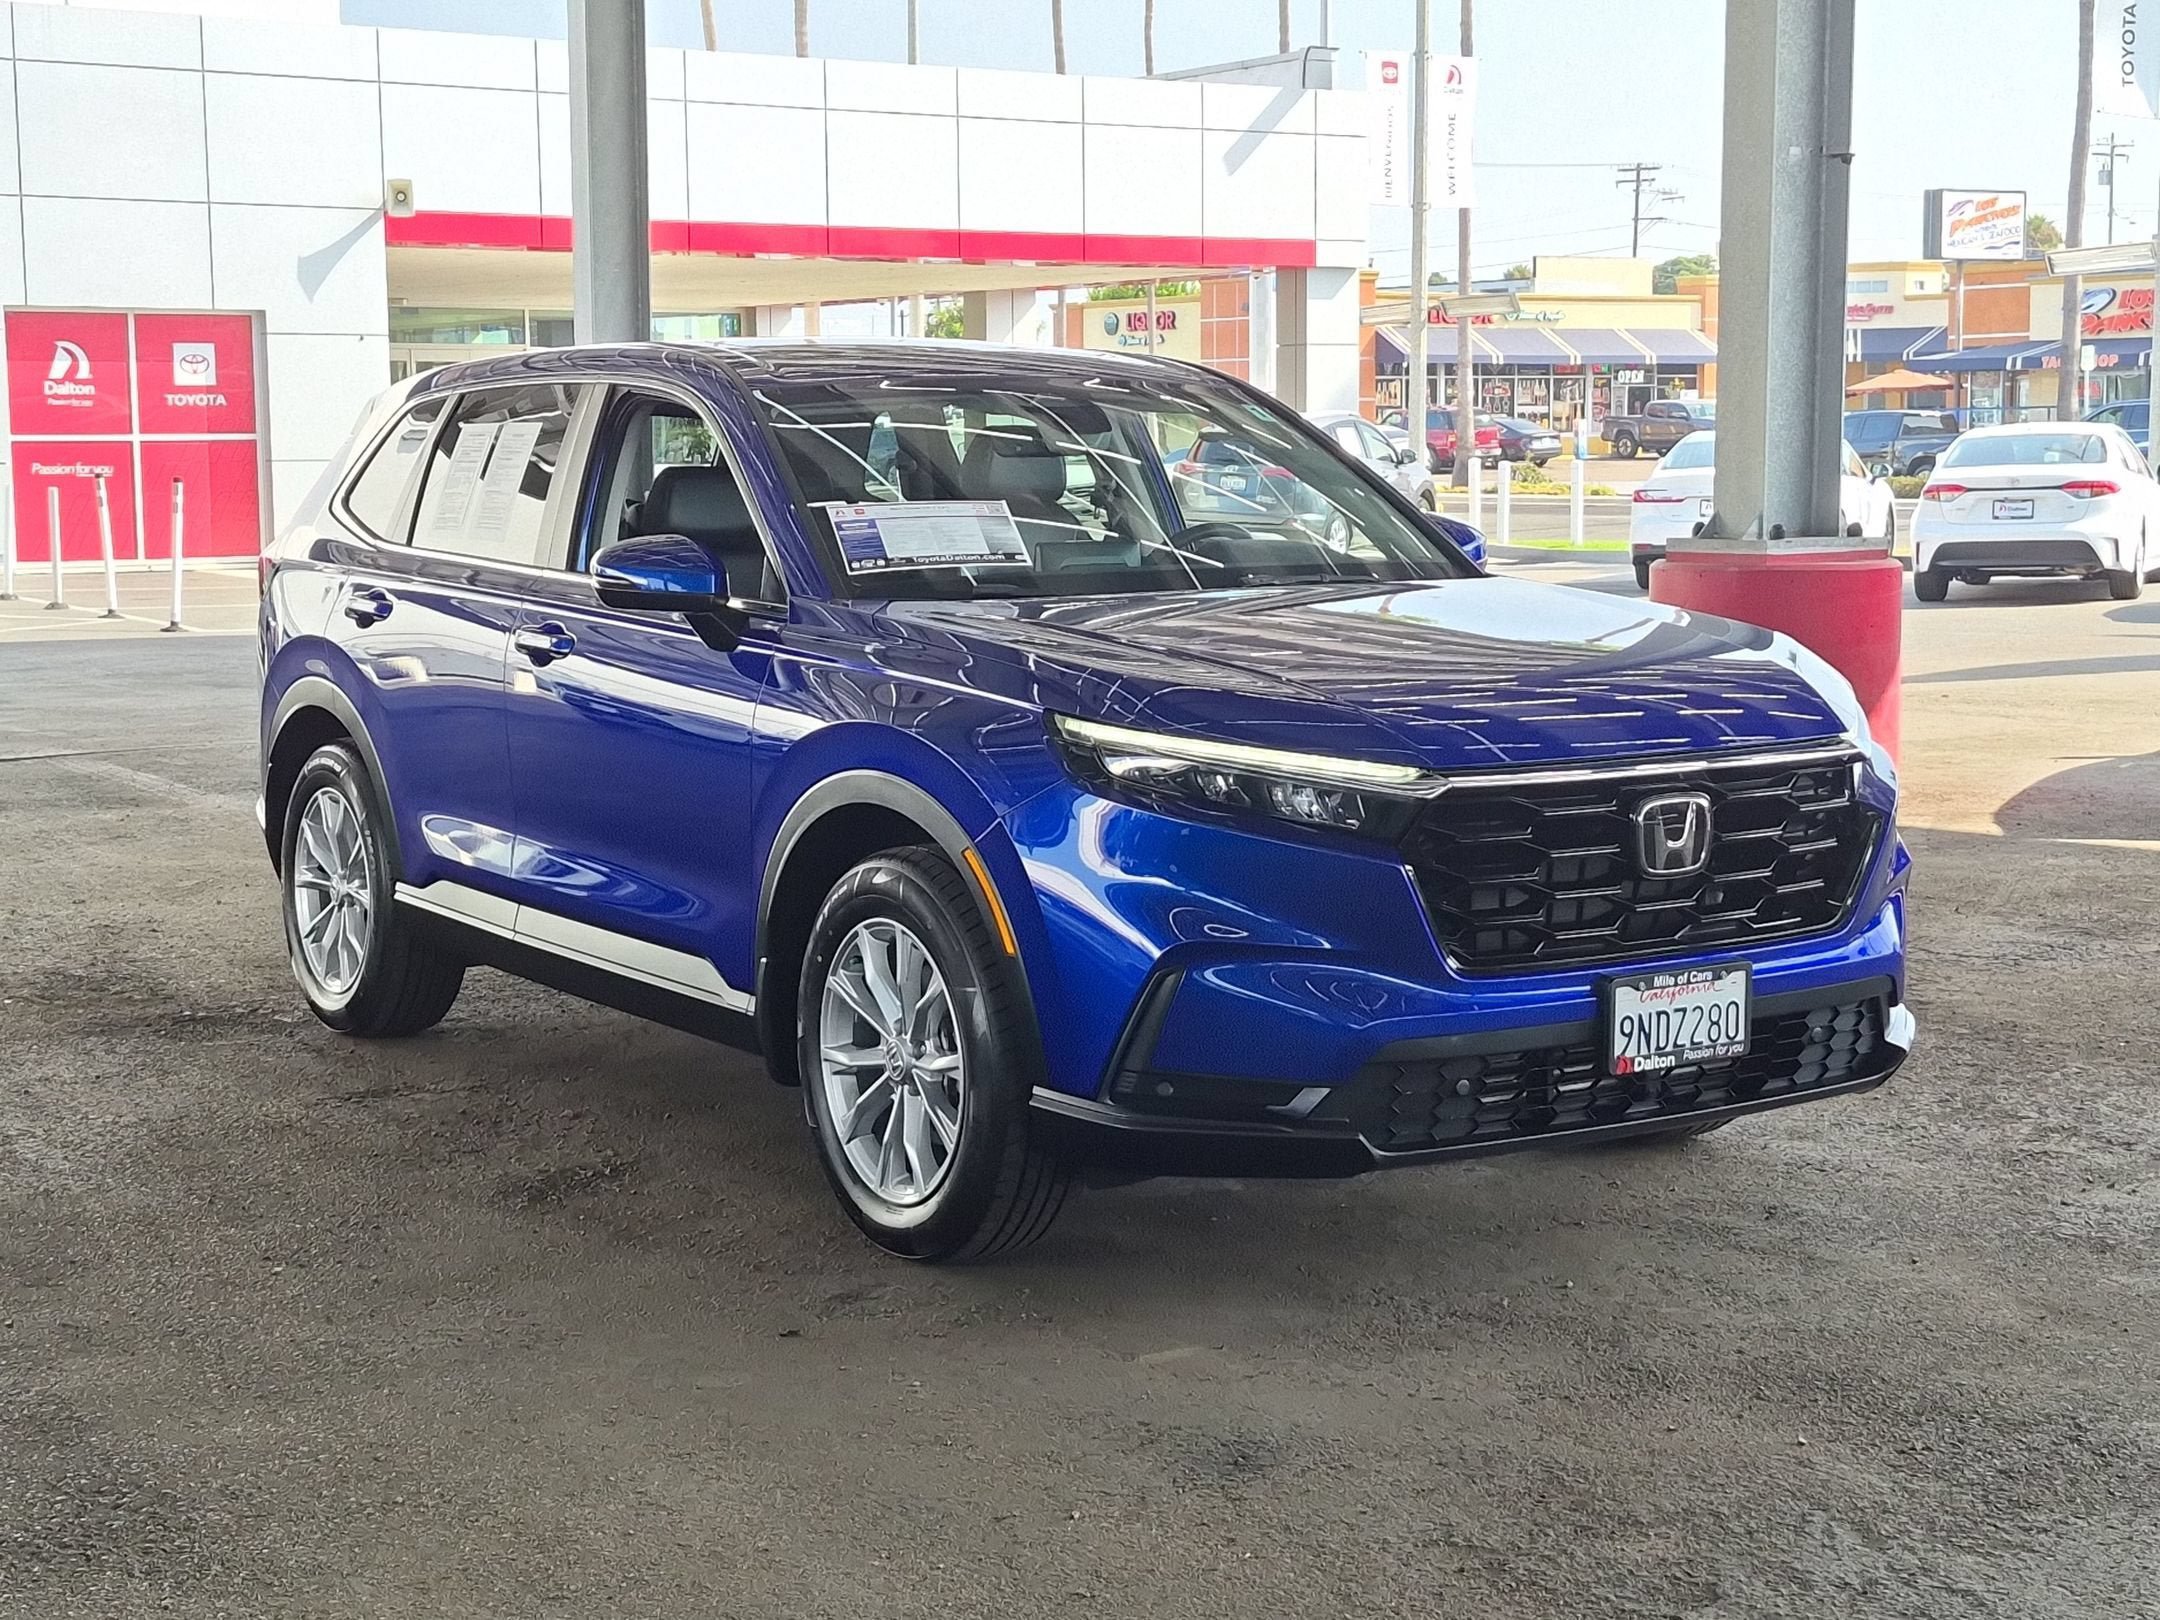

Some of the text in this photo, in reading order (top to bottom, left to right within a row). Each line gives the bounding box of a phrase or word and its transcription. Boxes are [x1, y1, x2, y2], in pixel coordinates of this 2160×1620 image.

[2121, 4, 2137, 88] TOYOTA
[1126, 311, 1177, 332] LIQOR
[43, 381, 96, 396] Dalton
[163, 393, 227, 407] TOYOTA
[1653, 971, 1713, 988] Mile of Cars
[1639, 981, 1724, 1005] California
[1619, 1000, 1740, 1056] 9NDZ280
[1633, 1043, 1744, 1073] Dalton Passion for you
